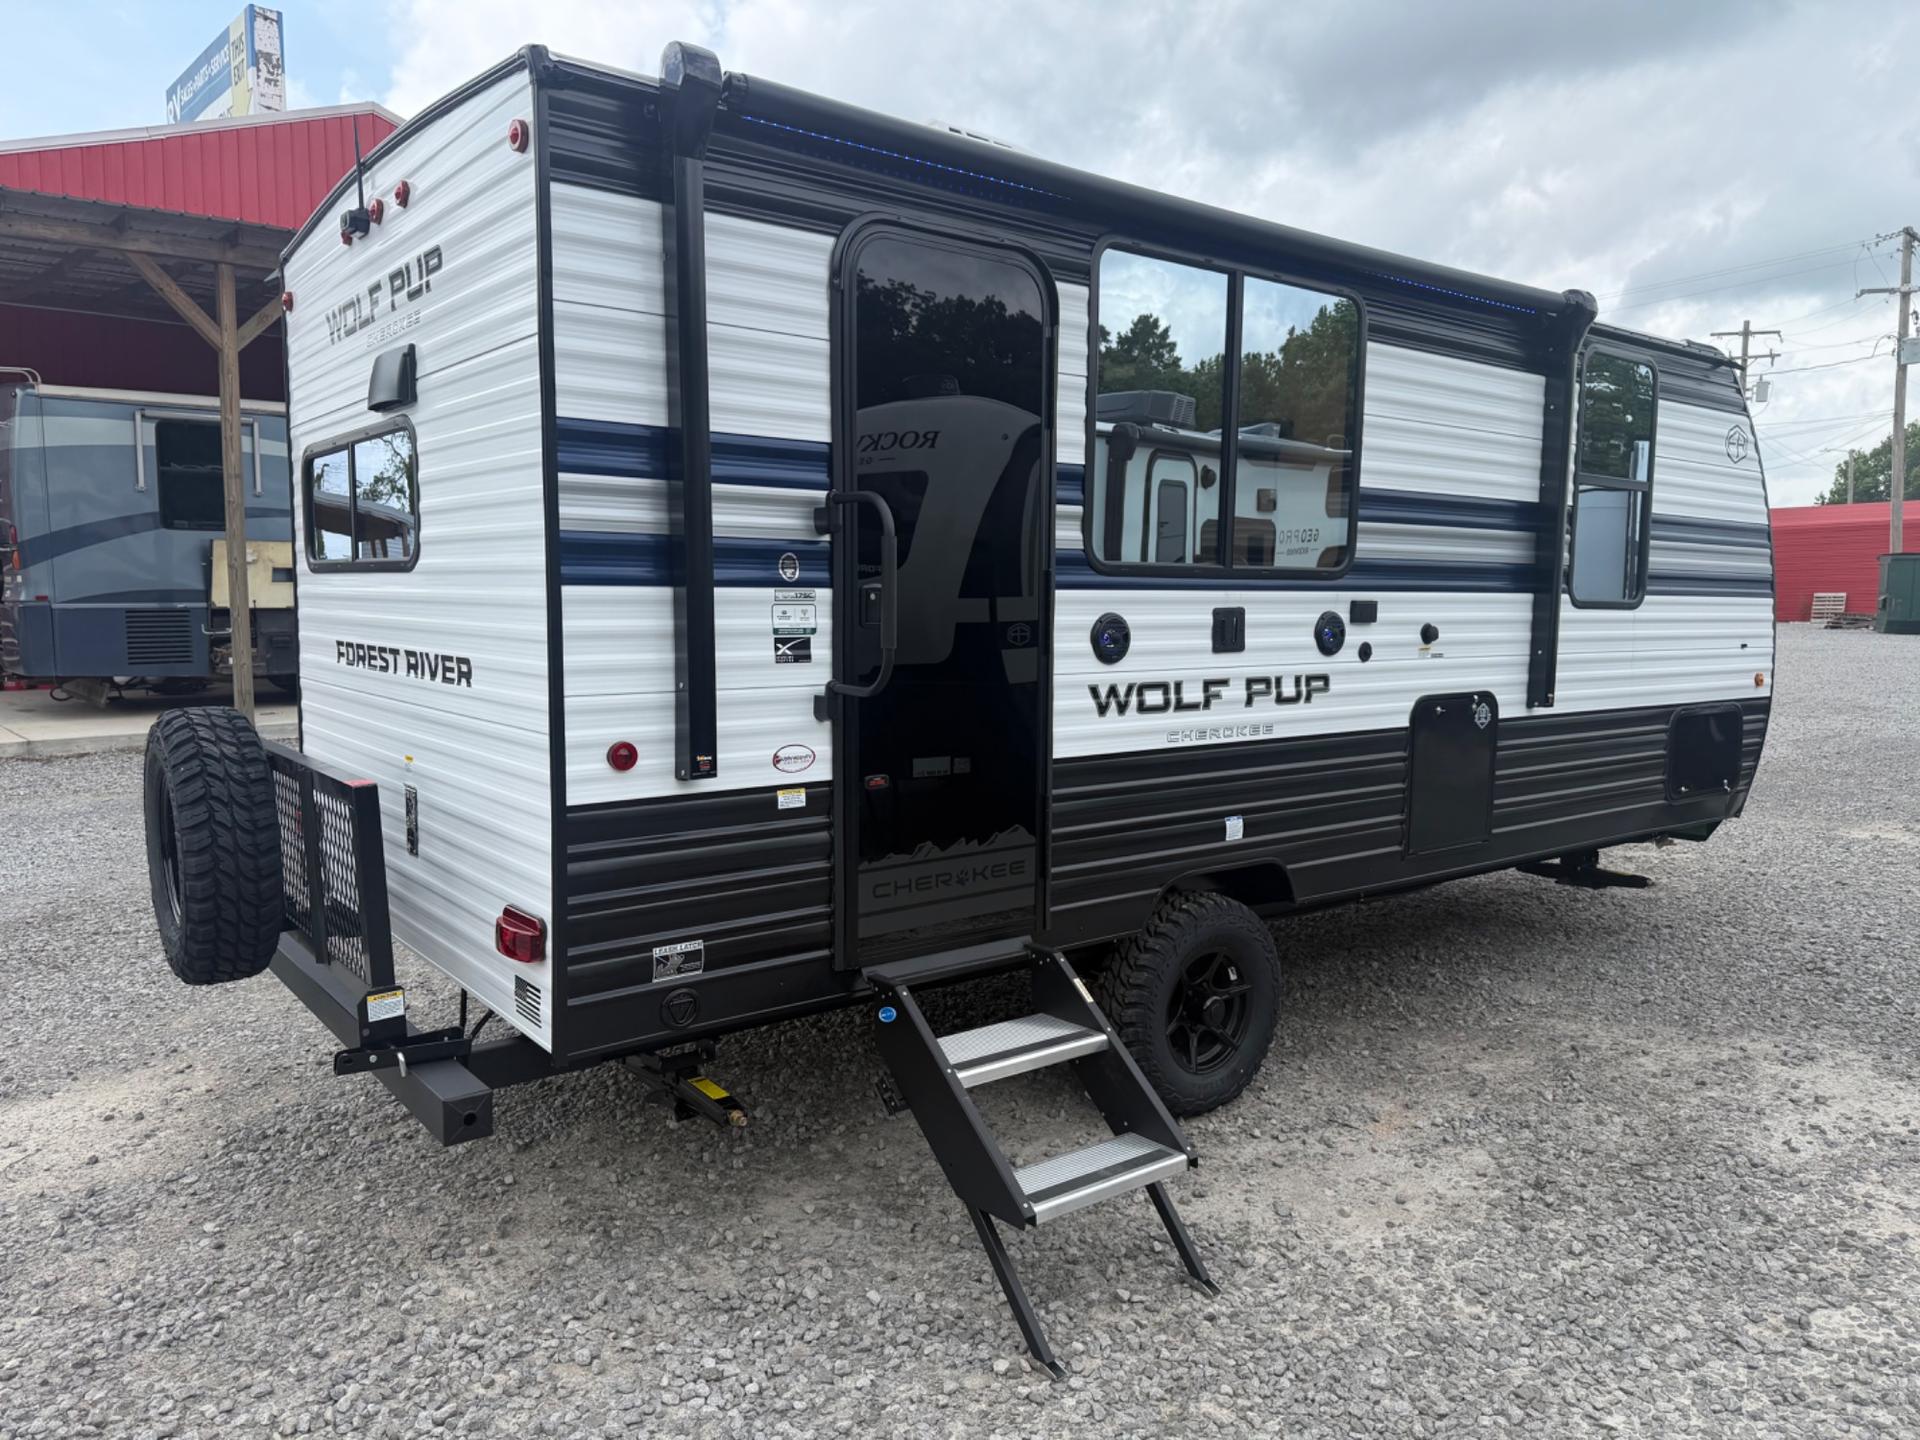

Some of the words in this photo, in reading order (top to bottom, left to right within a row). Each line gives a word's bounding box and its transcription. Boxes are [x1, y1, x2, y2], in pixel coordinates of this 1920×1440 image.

[325, 280, 382, 345] WOLF
[388, 244, 443, 312] PUP
[336, 640, 400, 674] FOREST
[404, 649, 473, 688] RIVER
[1088, 677, 1231, 718] WOLF
[1244, 673, 1331, 708] PUP
[1166, 723, 1275, 743] CHEROKEE
